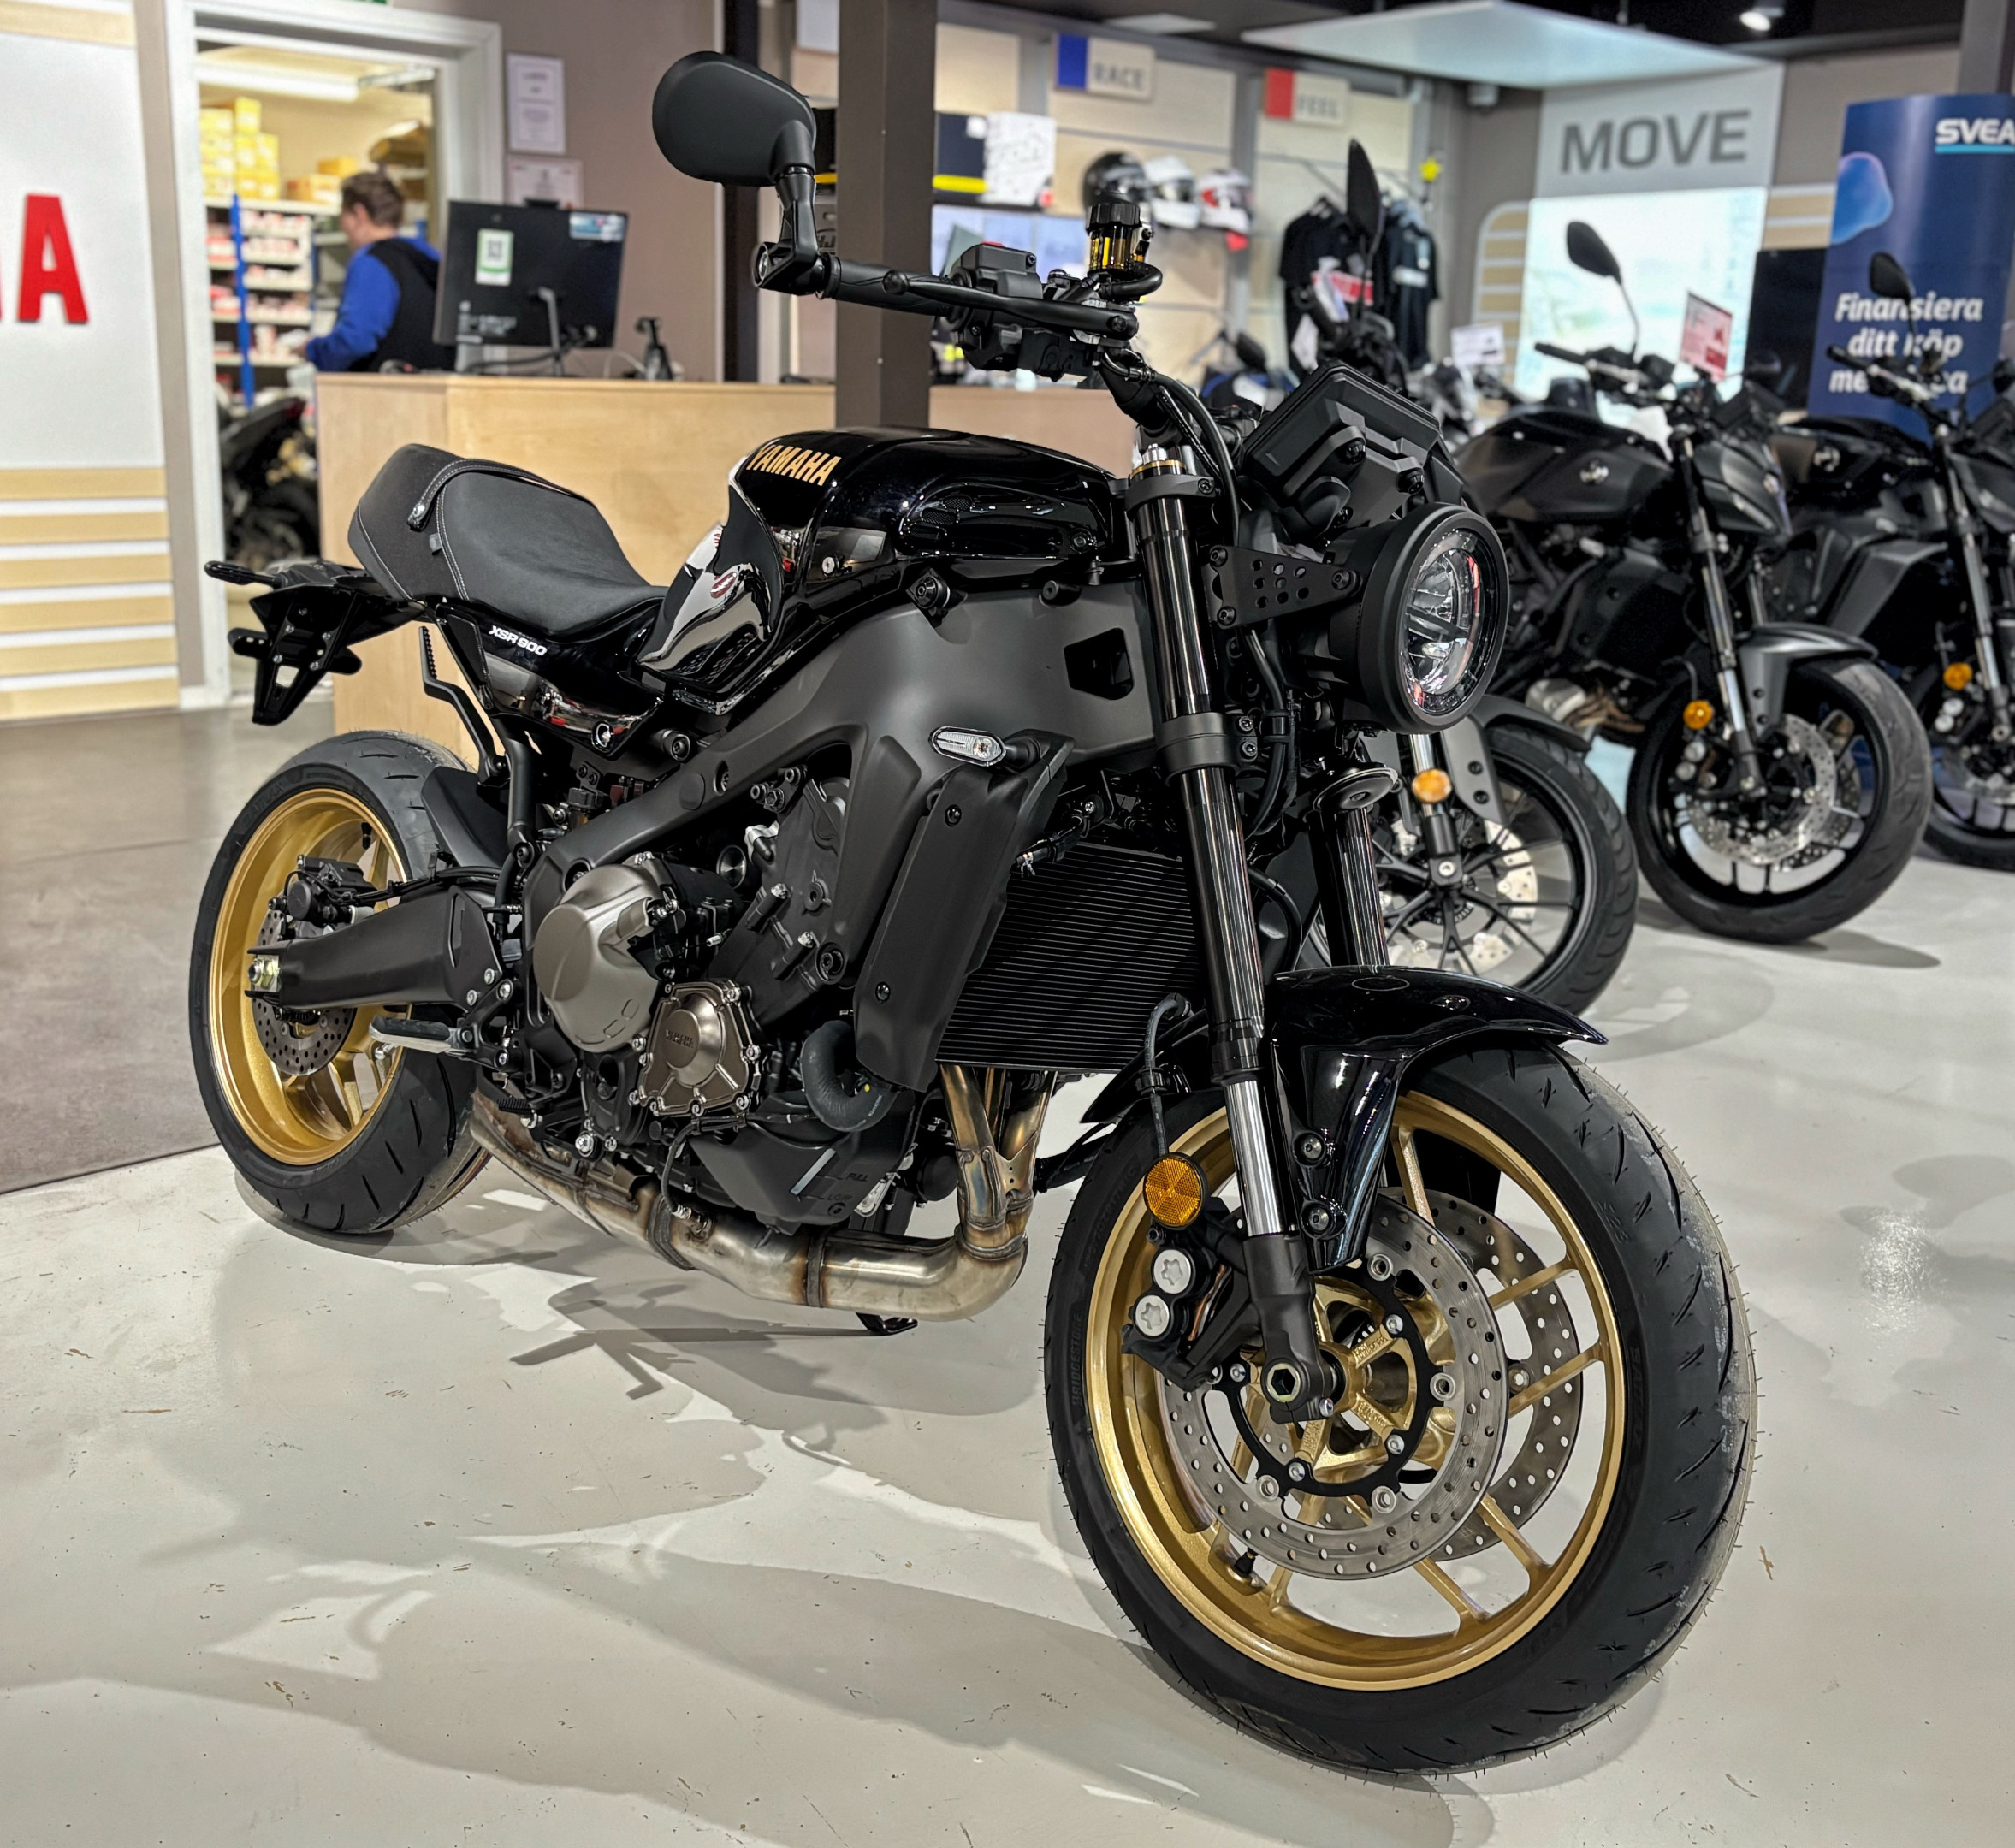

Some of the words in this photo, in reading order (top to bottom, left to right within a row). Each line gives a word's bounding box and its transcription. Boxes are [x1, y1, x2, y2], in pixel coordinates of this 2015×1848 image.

[1093, 61, 1146, 92] RACE
[1296, 93, 1338, 118] FEEL
[1560, 108, 1751, 175] MOVE
[1935, 117, 2015, 145] SVEA
[0, 193, 90, 325] A
[1834, 291, 1984, 322] Finansiera
[1846, 326, 1899, 358] ditt
[1828, 369, 1870, 393] me
[745, 443, 843, 487] YAMAHA
[1070, 1312, 1085, 1407] BRIDGESTONE
